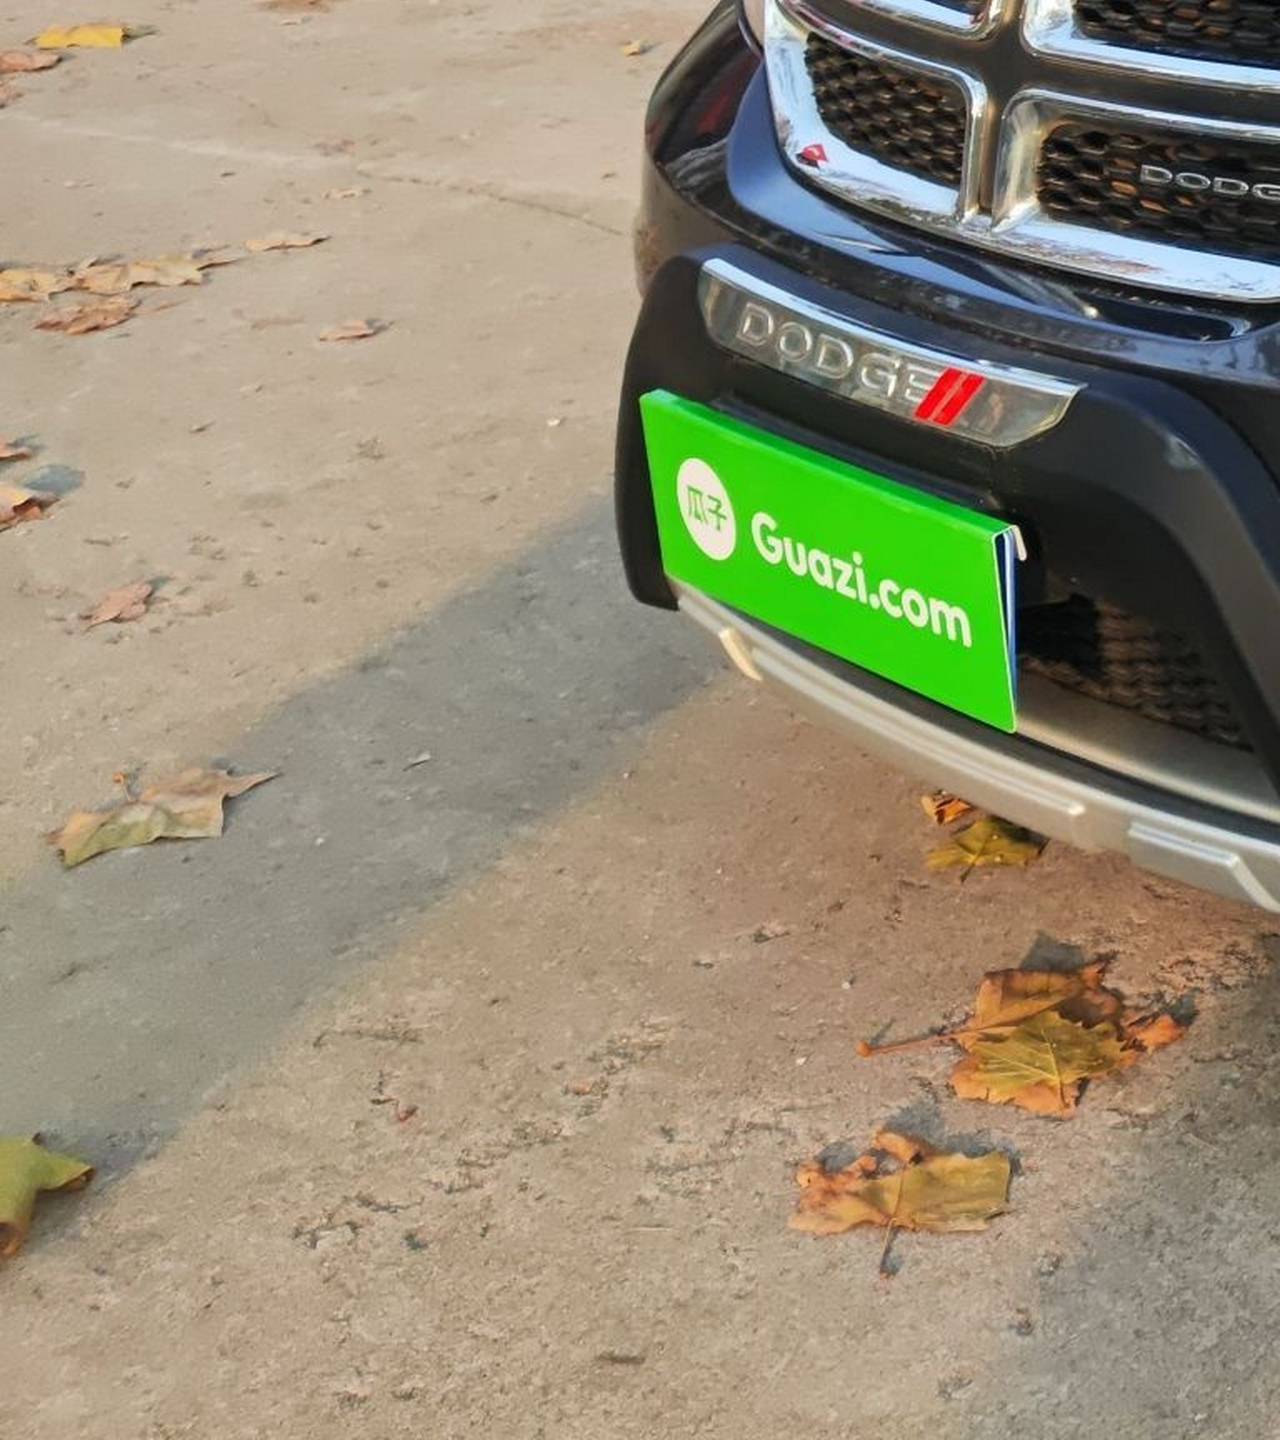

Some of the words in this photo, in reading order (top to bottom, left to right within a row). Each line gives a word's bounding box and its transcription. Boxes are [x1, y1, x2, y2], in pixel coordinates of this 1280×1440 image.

[737, 302, 943, 403] DODGE
[686, 484, 728, 532] 瓜子
[751, 511, 972, 648] Guazi.com
